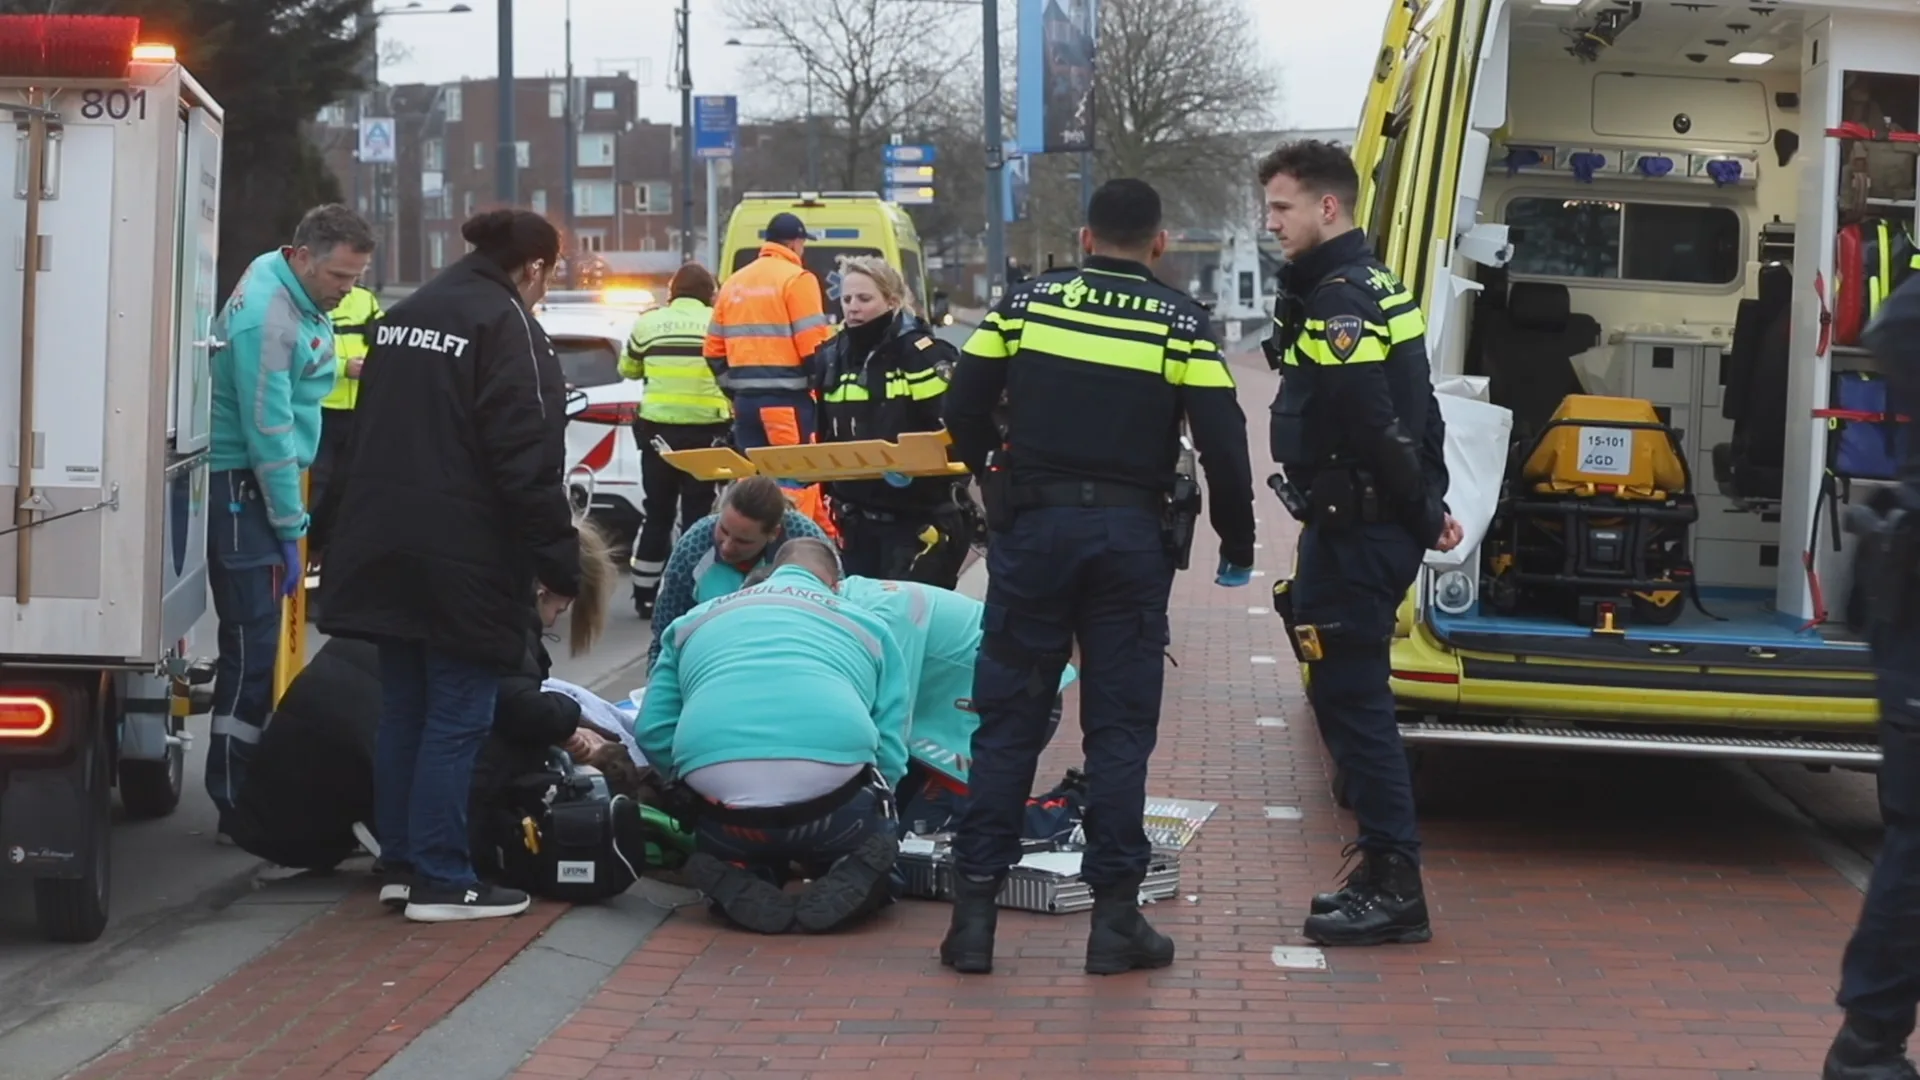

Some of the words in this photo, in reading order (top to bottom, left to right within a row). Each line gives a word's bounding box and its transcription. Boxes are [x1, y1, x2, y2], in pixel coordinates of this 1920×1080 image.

[81, 89, 146, 120] 801
[1048, 278, 1160, 313] POLITIE
[408, 327, 469, 357] DELFT
[1588, 436, 1624, 448] 15-101
